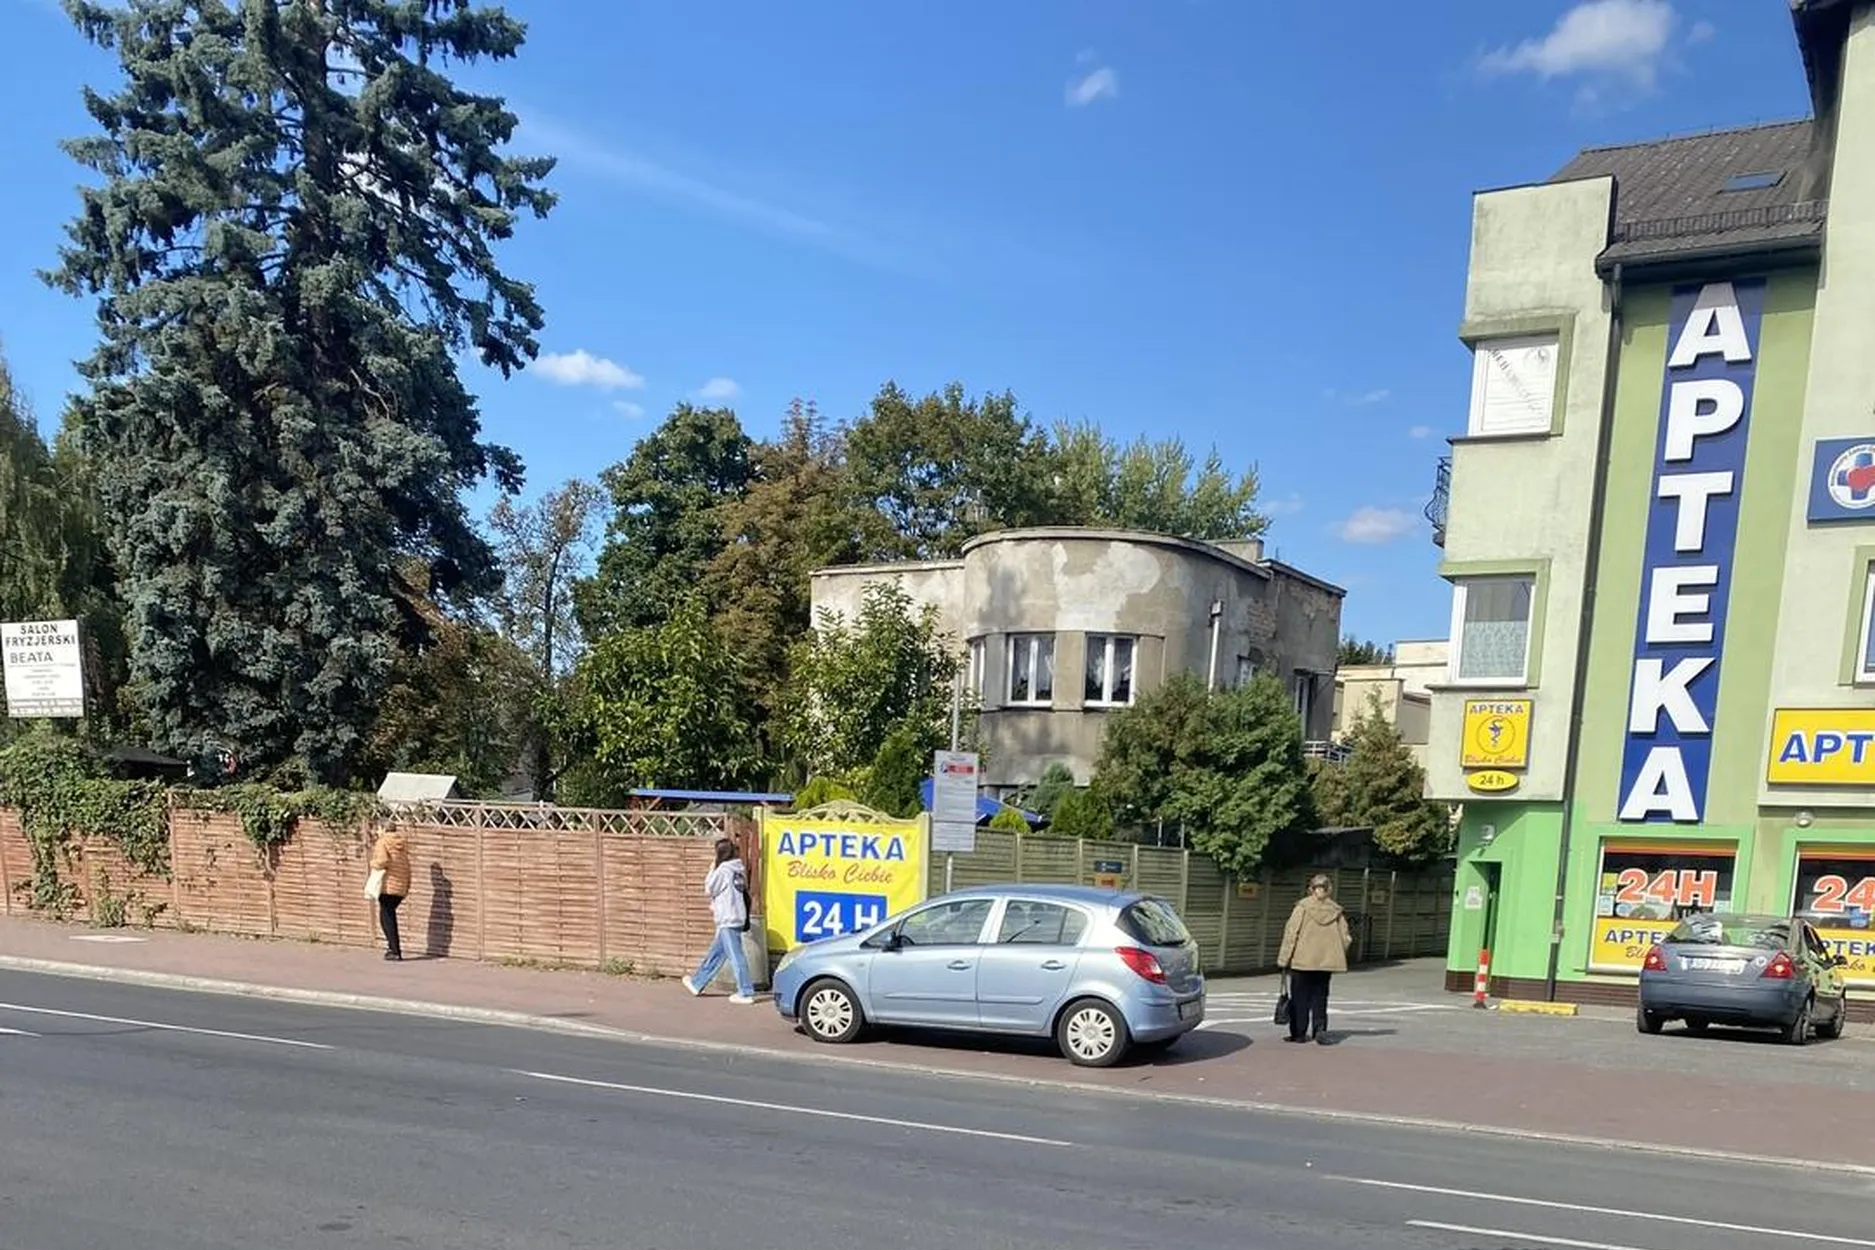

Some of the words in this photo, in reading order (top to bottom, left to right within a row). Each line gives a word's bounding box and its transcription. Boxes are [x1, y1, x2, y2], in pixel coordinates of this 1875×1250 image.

[1618, 281, 1753, 822] APTEKA
[20, 623, 58, 635] SALON
[5, 634, 76, 648] FRYZJERSKI
[10, 651, 54, 664] BEATA
[1470, 703, 1525, 715] APTEKA
[777, 832, 905, 861] APTEKA
[786, 860, 837, 880] Blisko
[843, 861, 894, 885] Ciebie
[1615, 867, 1718, 907] 24H
[802, 900, 844, 936] 24
[855, 903, 879, 931] H
[1604, 929, 1664, 945] APTE
